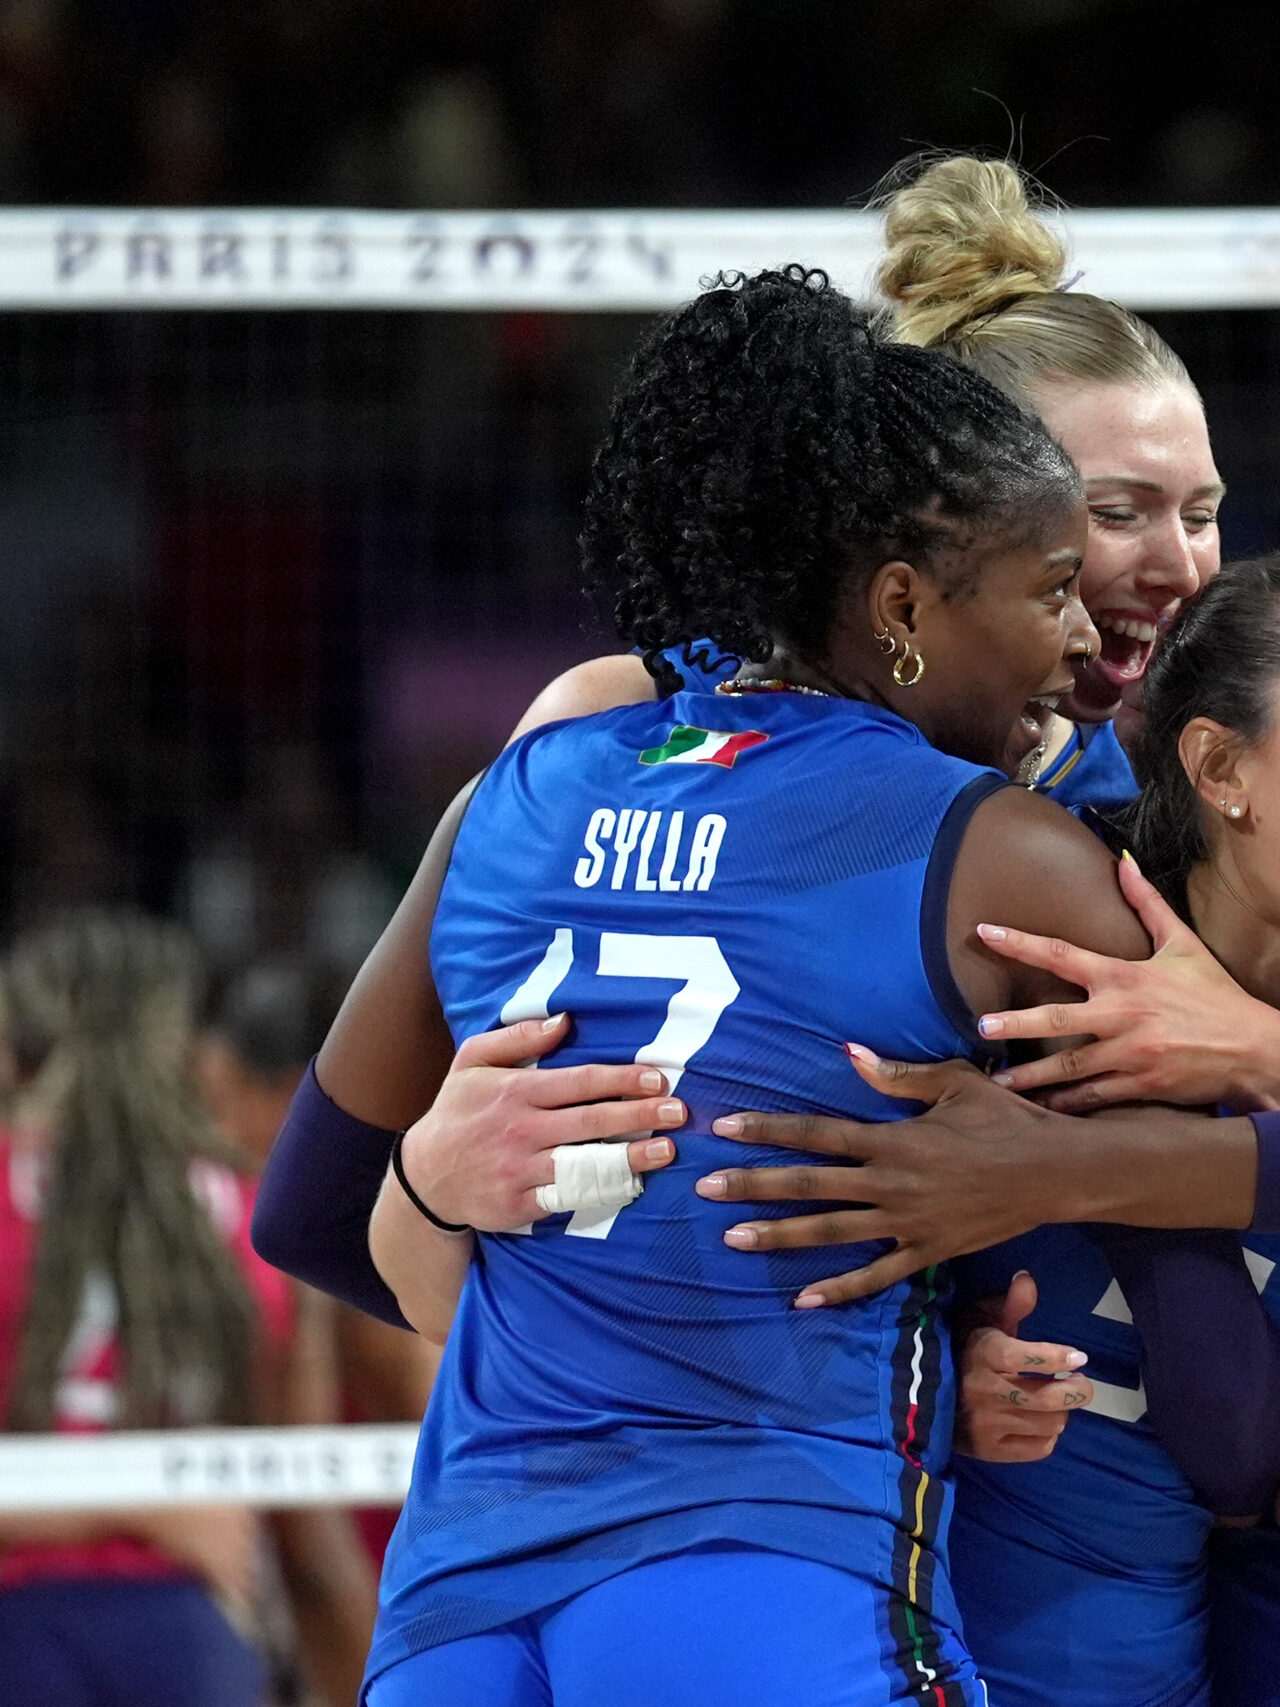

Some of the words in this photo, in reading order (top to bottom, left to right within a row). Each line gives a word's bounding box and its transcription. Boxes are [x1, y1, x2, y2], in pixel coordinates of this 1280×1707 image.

[54, 225, 358, 284] PARIS
[404, 225, 674, 284] 2024
[574, 807, 728, 892] SYLLA
